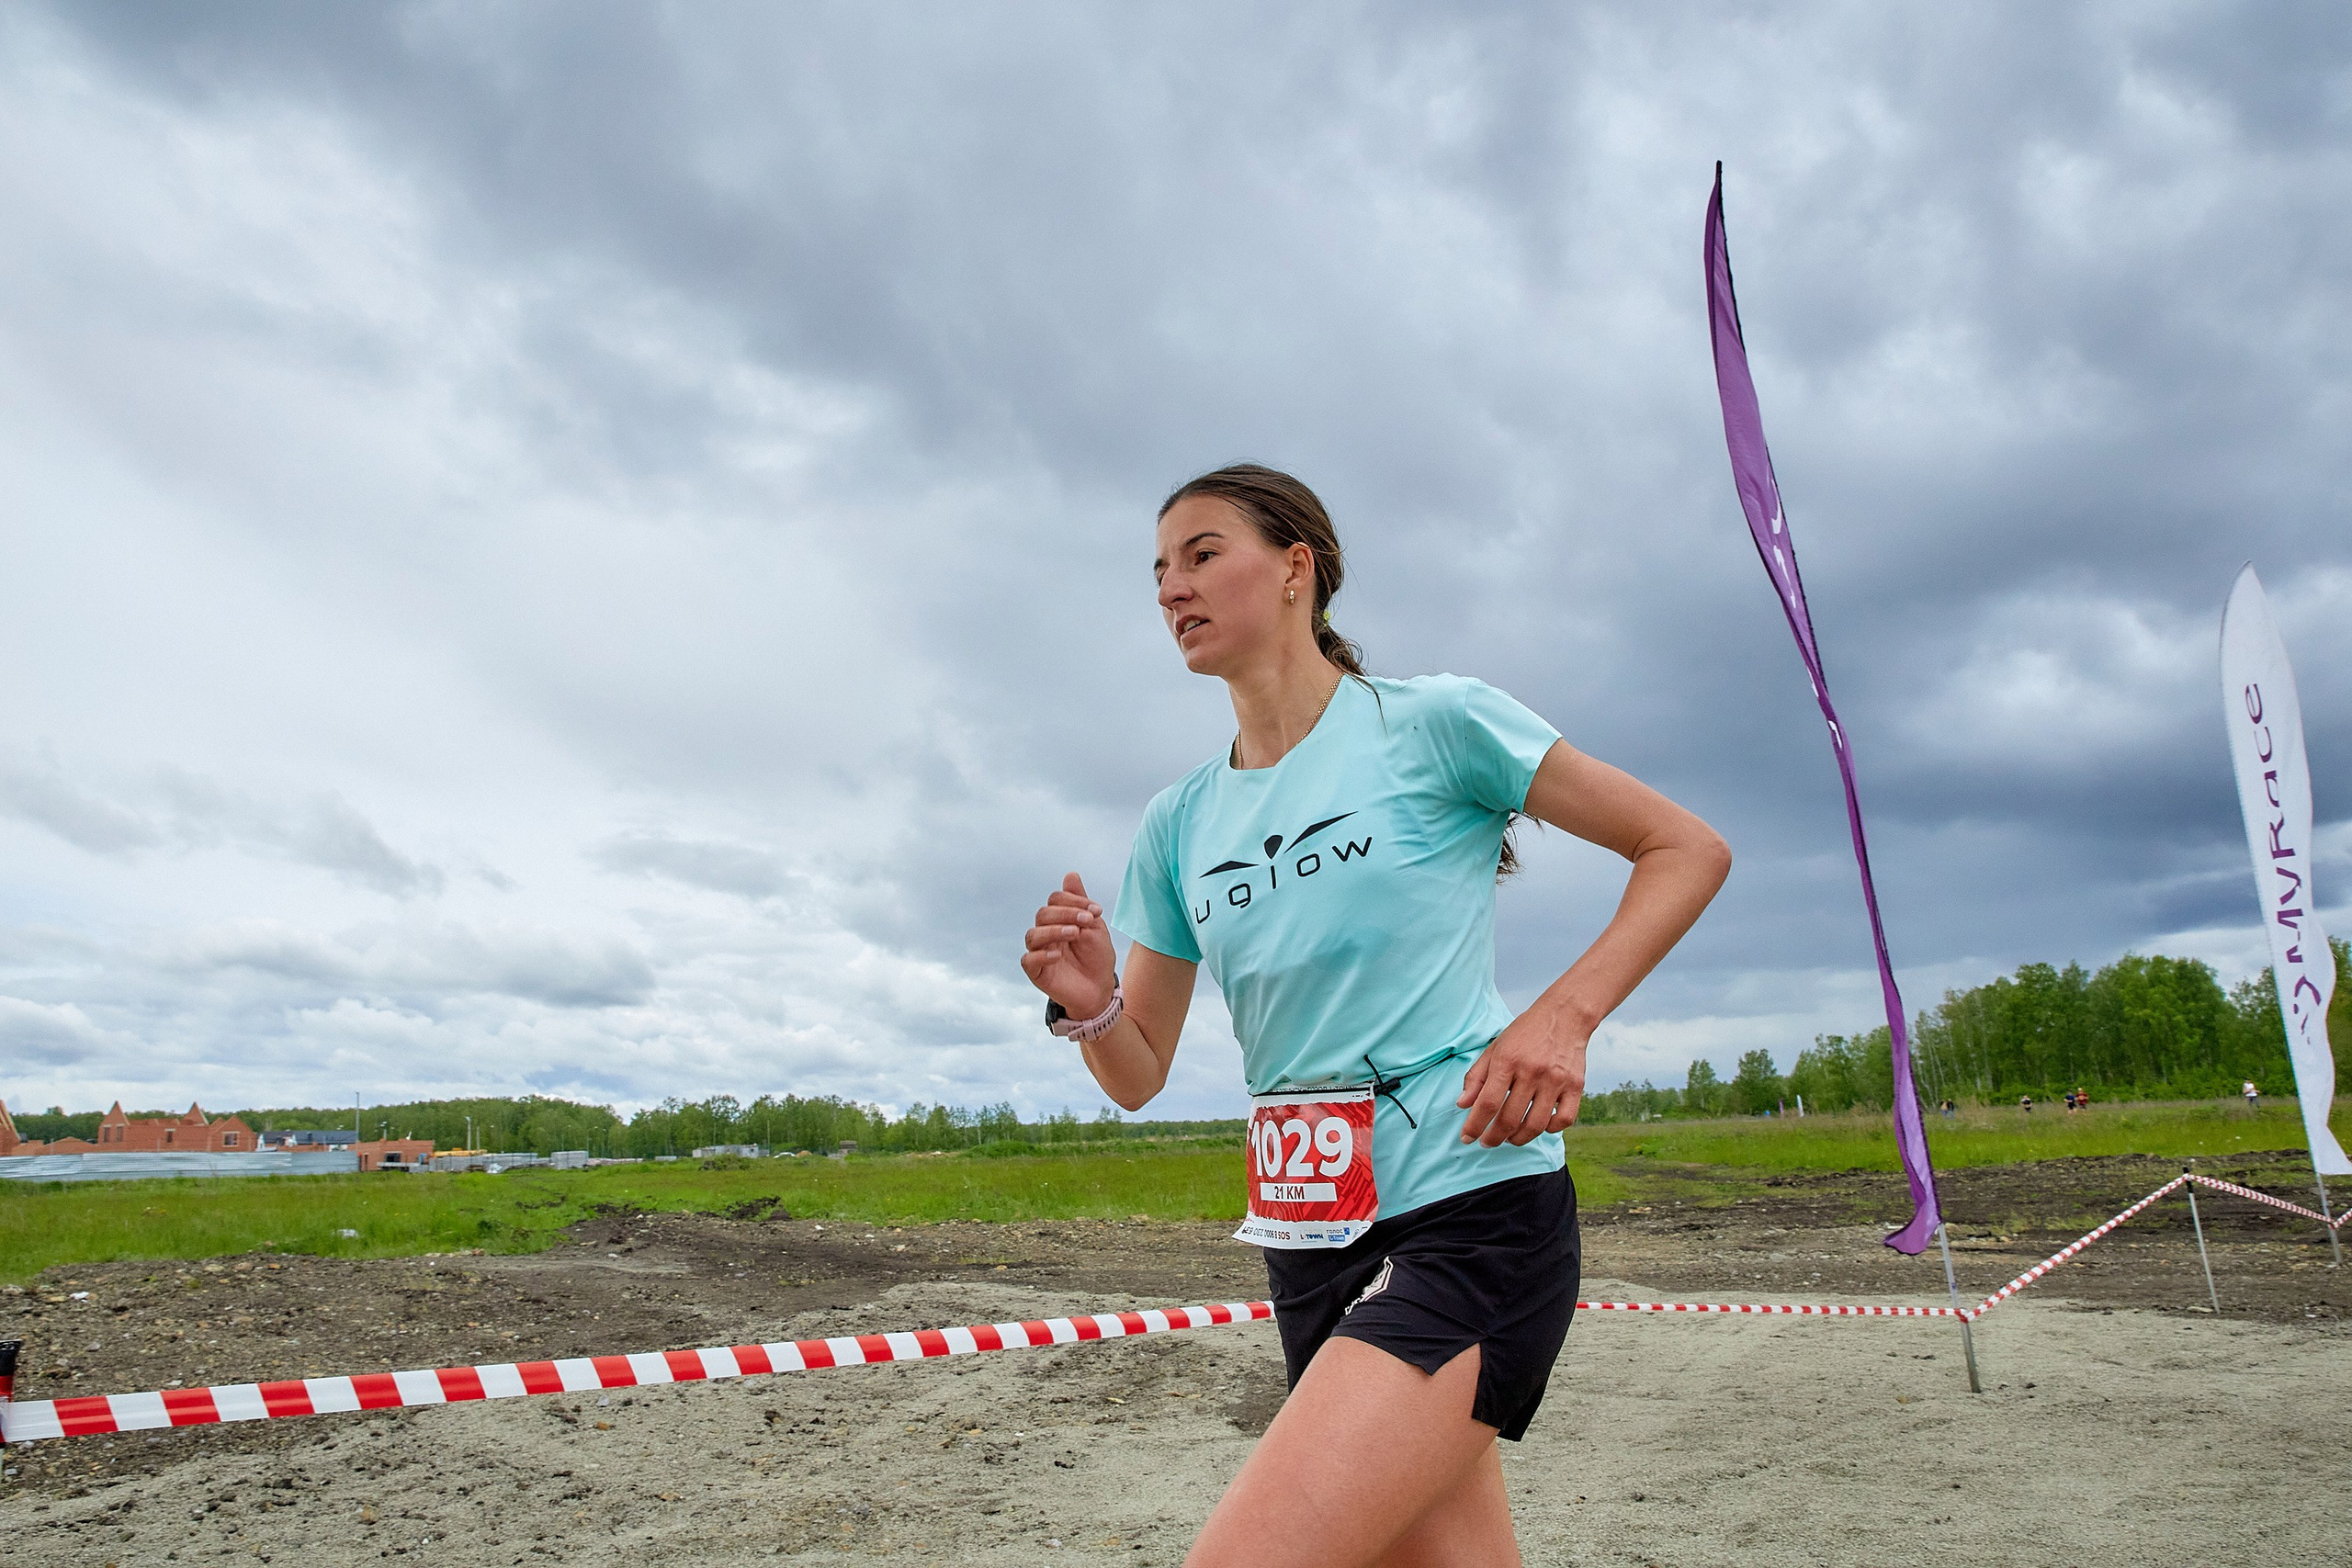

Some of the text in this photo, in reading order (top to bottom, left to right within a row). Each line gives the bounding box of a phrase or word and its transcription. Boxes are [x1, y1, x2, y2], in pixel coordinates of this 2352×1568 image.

[1250, 1116, 1353, 1178] 1029
[1273, 1185, 1305, 1200] 21 KM
[1278, 1231, 1291, 1240] SOS
